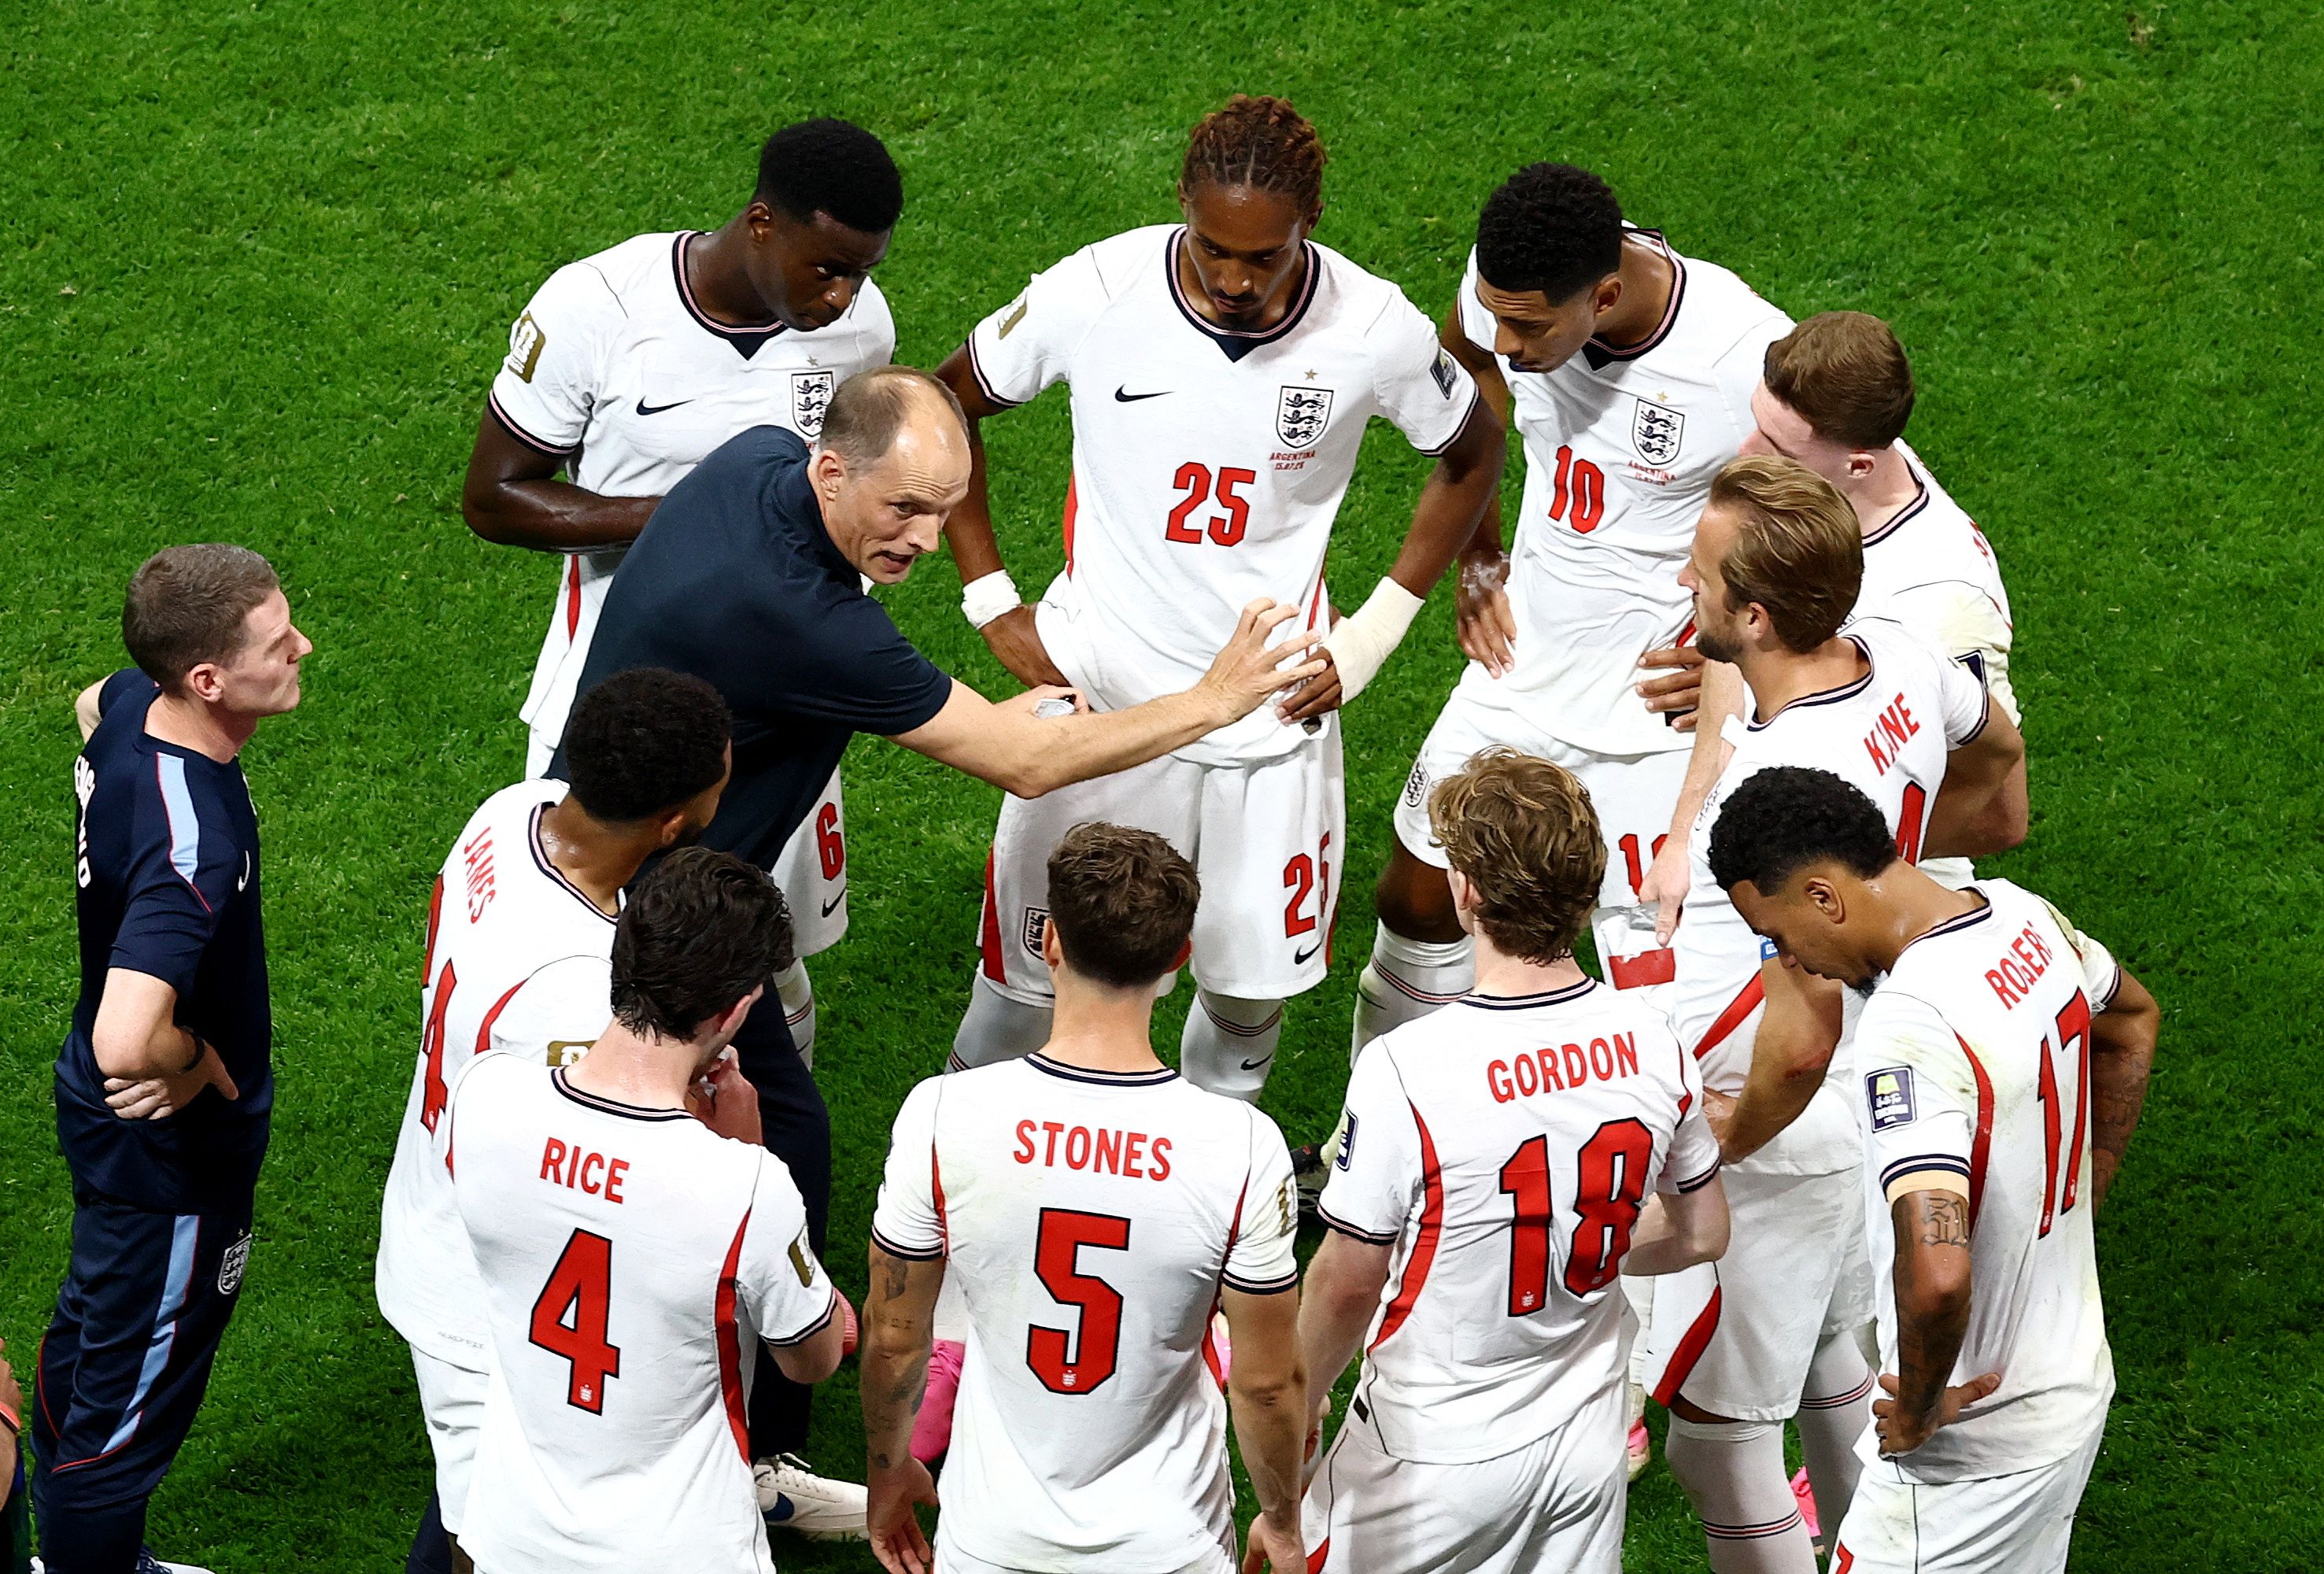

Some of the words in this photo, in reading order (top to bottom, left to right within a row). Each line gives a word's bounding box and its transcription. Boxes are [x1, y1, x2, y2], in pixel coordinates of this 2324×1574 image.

[1269, 449, 1317, 461] ARGENTINA
[1547, 444, 1605, 535] 10
[1165, 461, 1257, 548] 25
[464, 826, 497, 925] JAMES
[815, 801, 845, 881] 6
[1619, 833, 1669, 897] 1
[1487, 1031, 1639, 1104] GORDON
[1012, 1118, 1173, 1182] STONES
[2037, 985, 2091, 1239] 17
[539, 1136, 630, 1204] RICE
[1499, 1117, 1653, 1317] 18
[528, 1227, 620, 1416] 4
[1025, 1206, 1131, 1395] 5
